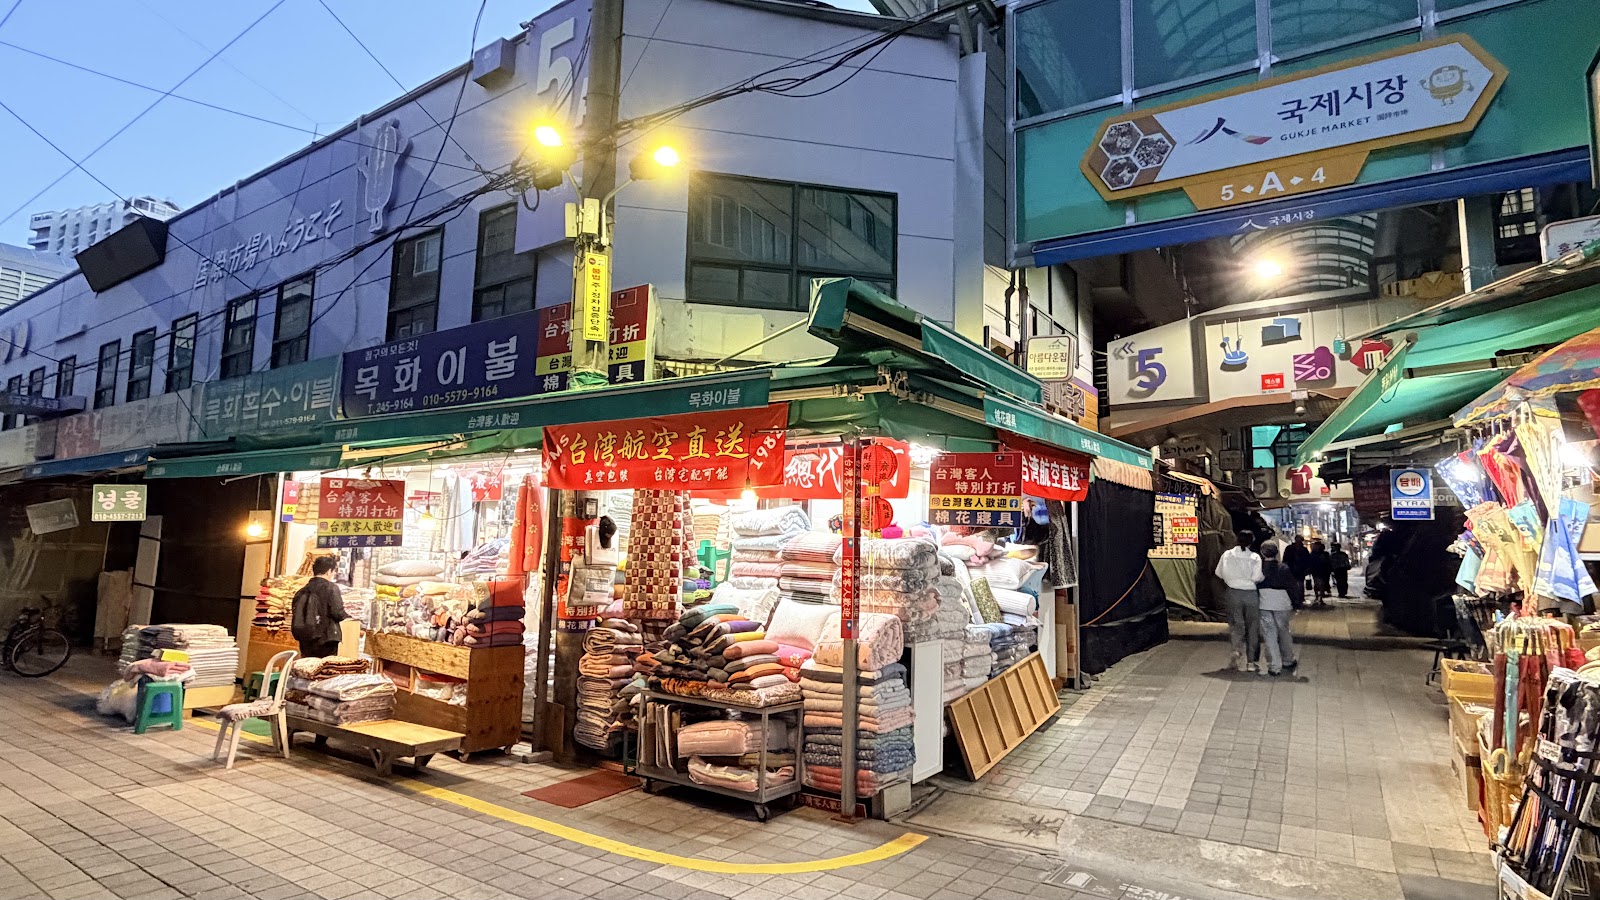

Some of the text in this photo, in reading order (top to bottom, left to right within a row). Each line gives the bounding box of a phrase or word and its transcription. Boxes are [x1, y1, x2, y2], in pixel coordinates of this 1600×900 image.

[1277, 75, 1409, 124] 국제시장
[1280, 116, 1371, 141] GUKJE MARKET
[1220, 166, 1326, 201] 5 A 4
[1268, 209, 1316, 226] 국제시장
[1028, 352, 1067, 363] 아름다운집
[1137, 347, 1167, 390] 5
[367, 384, 498, 415] T.245-9164 010-5579-9164
[688, 388, 741, 408] 목화이불
[569, 421, 750, 467] 台湾航空直送
[935, 468, 993, 481] 台灣客人
[955, 481, 1017, 496] 特別打折
[1399, 478, 1422, 488] 담배
[325, 490, 387, 504] 台灣客人
[941, 496, 1007, 509] 台灣客人歡迎
[338, 505, 399, 518] 特別打折
[330, 521, 393, 533] 台灣客人歡迎
